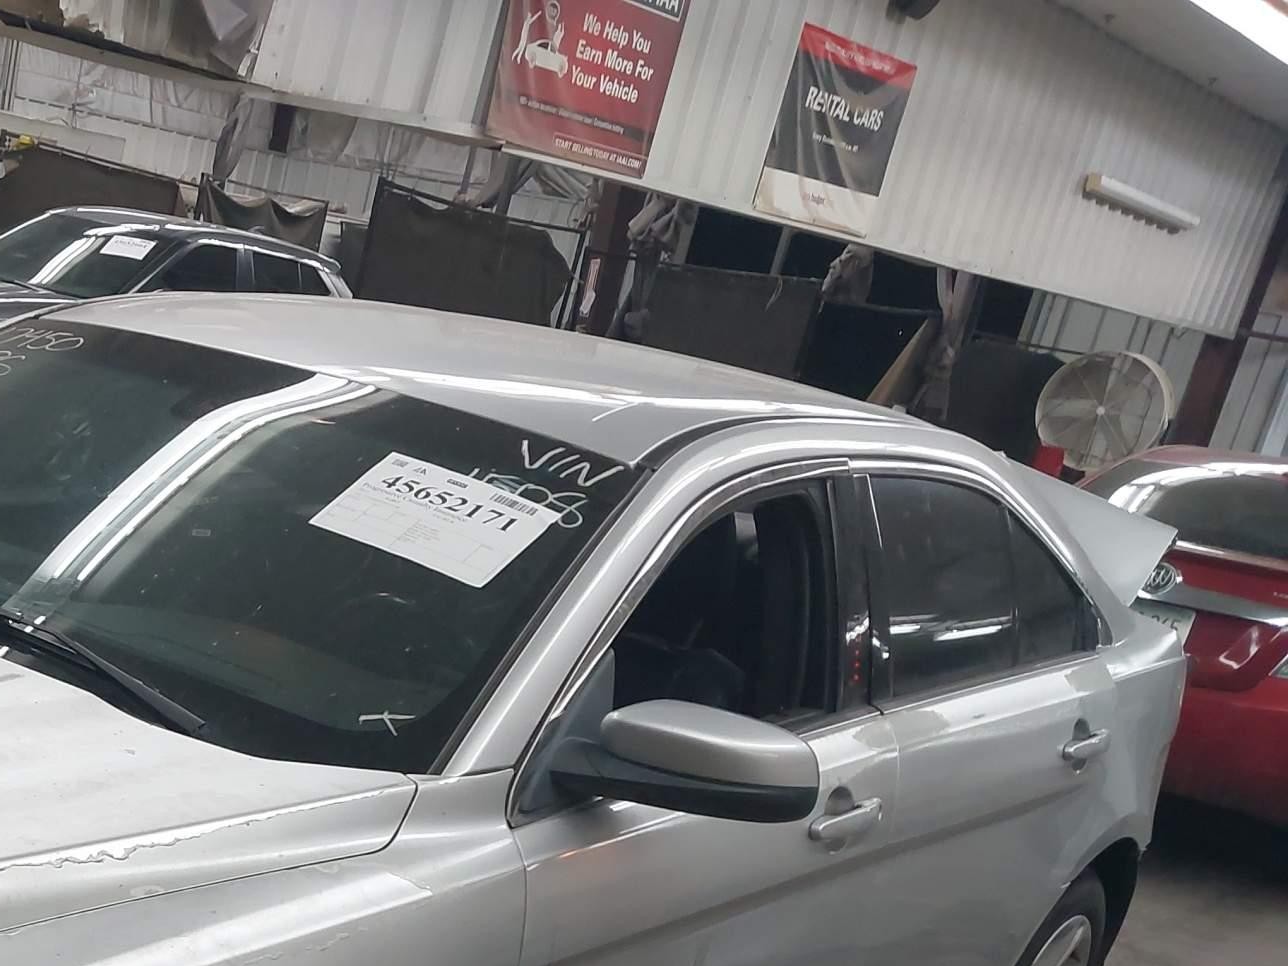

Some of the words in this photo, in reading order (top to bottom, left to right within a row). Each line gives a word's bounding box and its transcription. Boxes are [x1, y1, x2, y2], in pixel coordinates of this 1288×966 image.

[582, 13, 601, 36] We
[603, 20, 629, 48] Help
[631, 29, 652, 54] You
[575, 39, 602, 65] Earn
[604, 49, 633, 74] More
[634, 61, 654, 81] For
[571, 65, 597, 90] Your
[599, 75, 639, 104] Vehicle
[805, 86, 851, 122] RENTAL
[853, 108, 884, 131] CARS
[521, 439, 625, 487] VIN
[382, 475, 518, 532] 45652171
